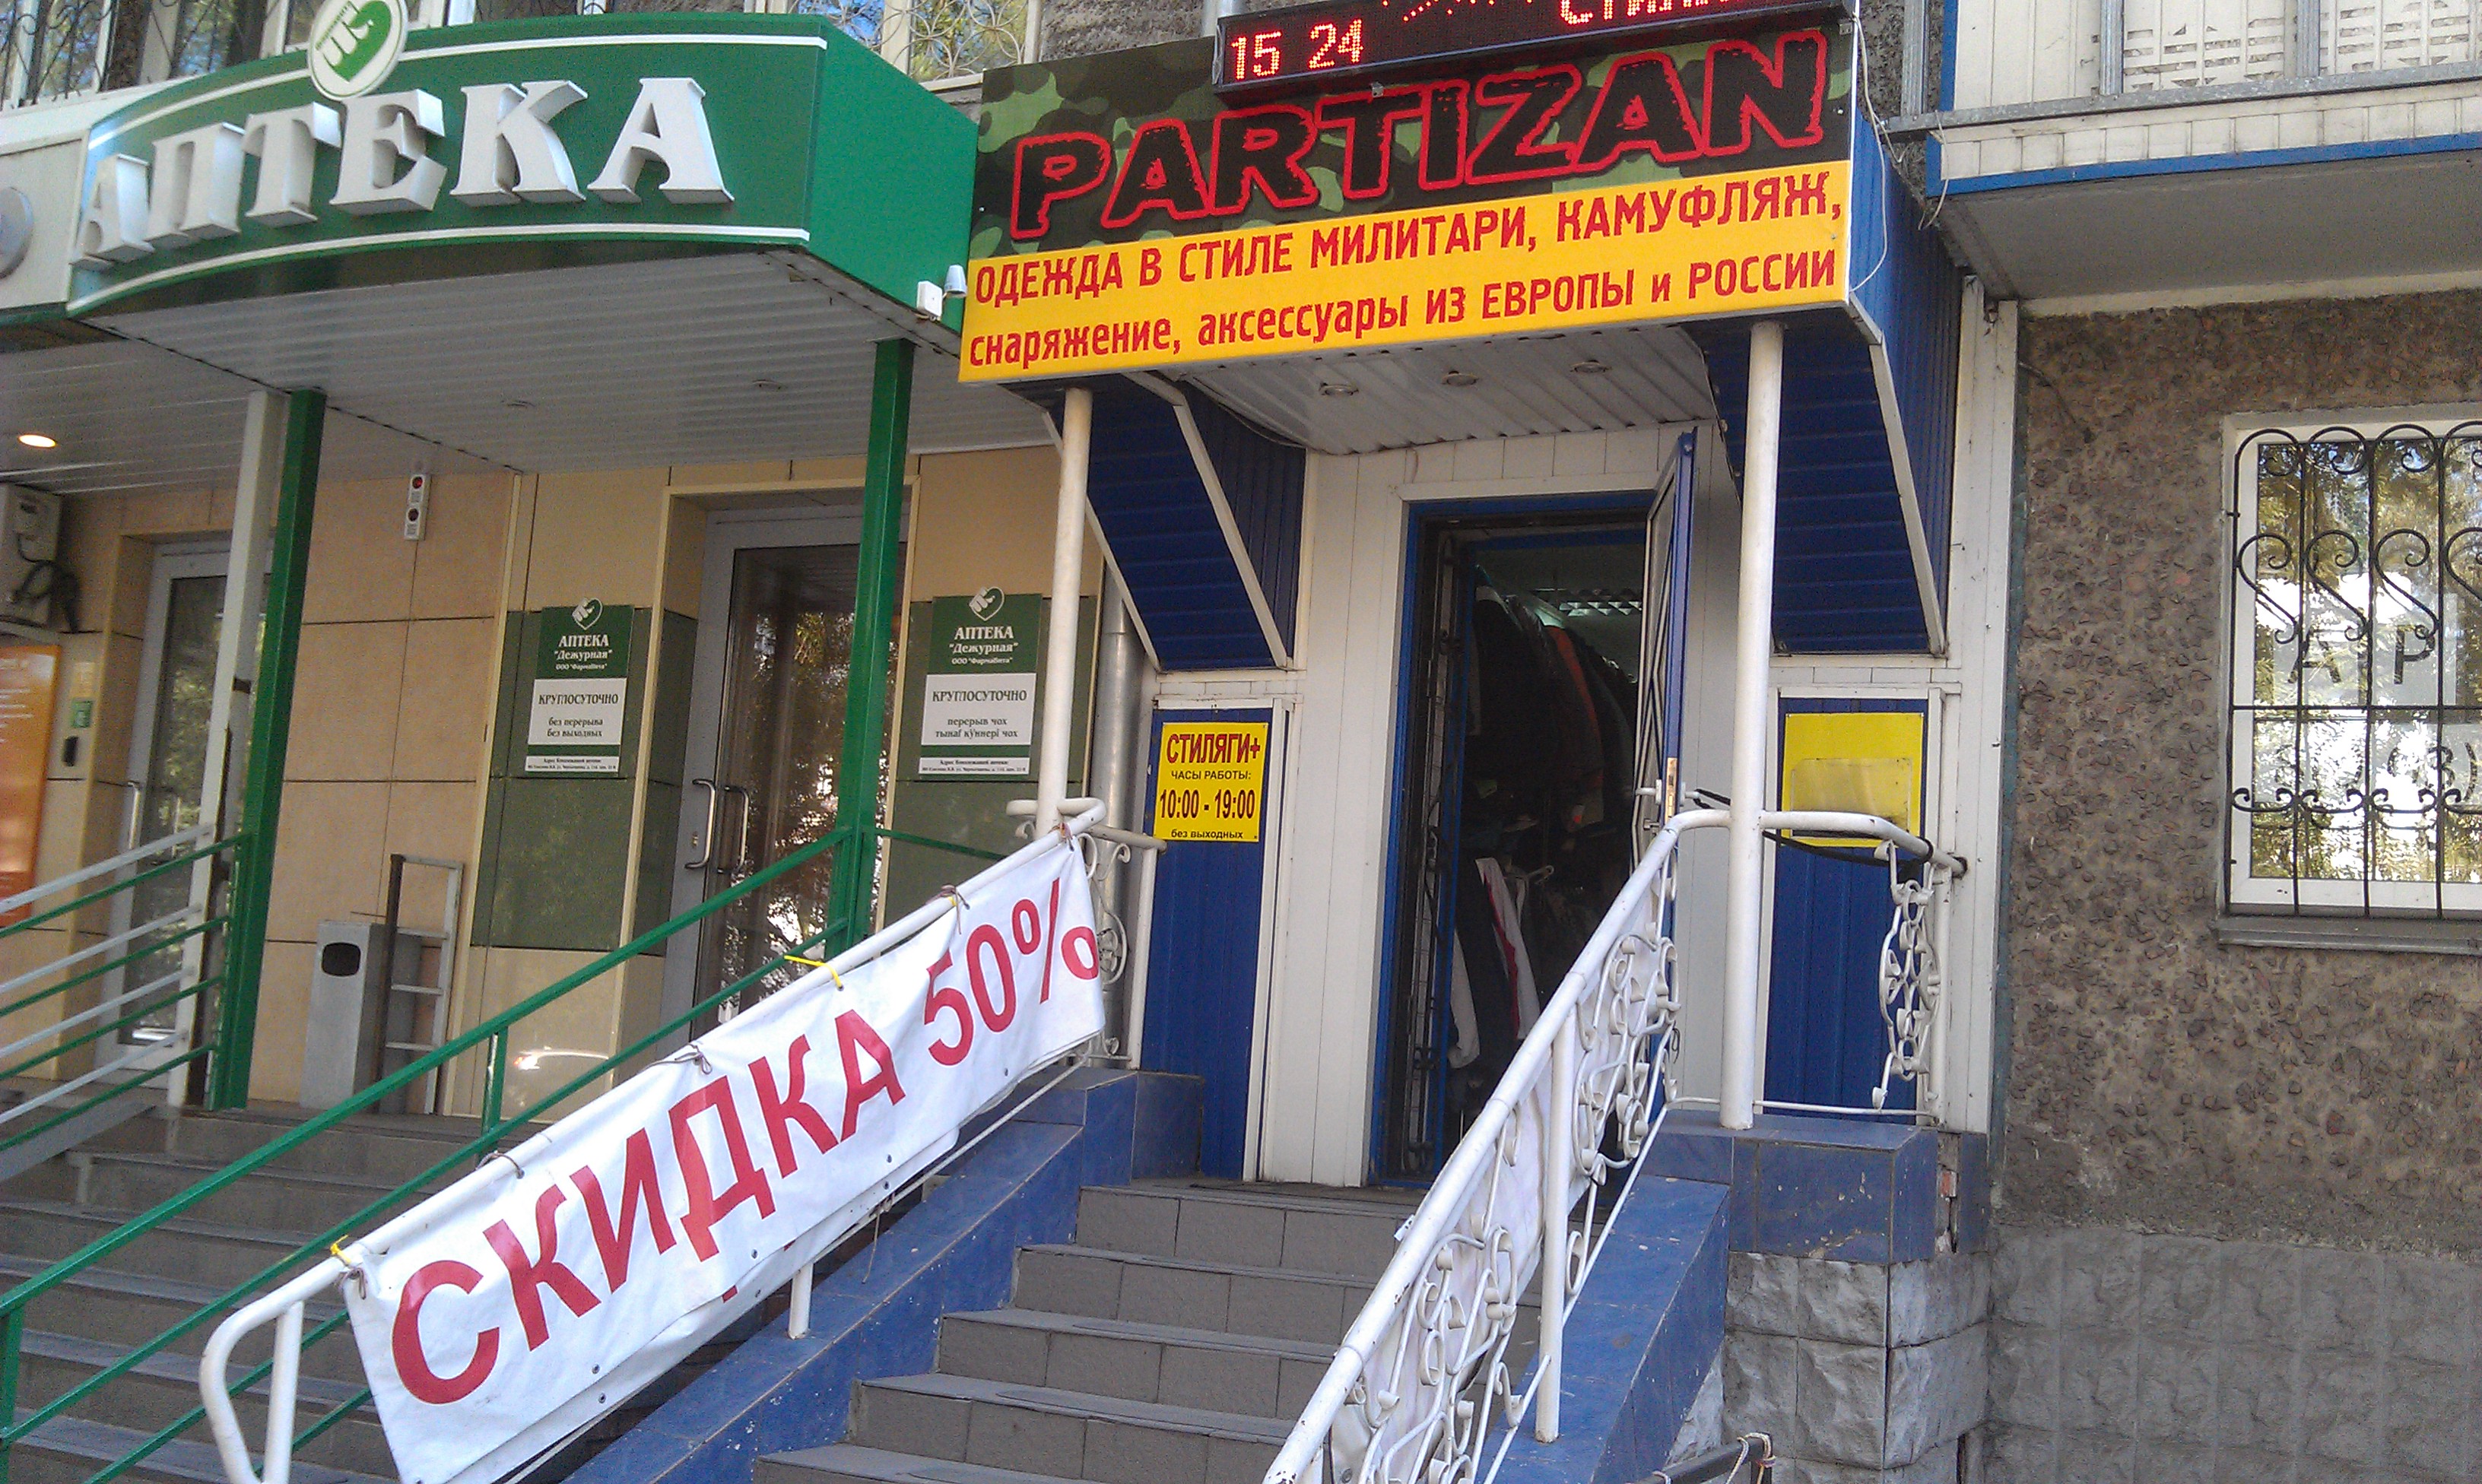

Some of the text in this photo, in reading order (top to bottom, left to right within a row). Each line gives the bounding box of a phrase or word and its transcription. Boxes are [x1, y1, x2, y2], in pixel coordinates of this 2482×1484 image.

[1230, 18, 1363, 81] 15 24
[1010, 28, 1828, 239] PARTIZAN
[68, 76, 735, 271] АПТЕКА
[976, 170, 1842, 307] ОДЕЖДА В СТИЛЕ МИЛИТАРИ, КАМУФЛЯЖ,
[970, 249, 1835, 369] снаряжение, аксессуары ИЗ ЕВРОПЫ и РОССИИ
[558, 634, 610, 648] АПТЕКА
[954, 626, 1014, 640] АПТЕКА
[949, 642, 1019, 655] "Дежурная"
[538, 693, 619, 706] КРУГЛОСУТОЧНО
[932, 690, 1027, 702] КРУГЛОСУТОЧНО
[947, 718, 989, 727] перерыв
[1166, 733, 1260, 764] СТИЛЯГИ+
[1171, 770, 1252, 780] ЧАСЫ РАБОТЫ:
[1160, 788, 1199, 819] 10:00
[1214, 788, 1255, 820] 19:00
[1171, 829, 1243, 839] без выходных
[390, 878, 1100, 1406] СКИДКА 50%
